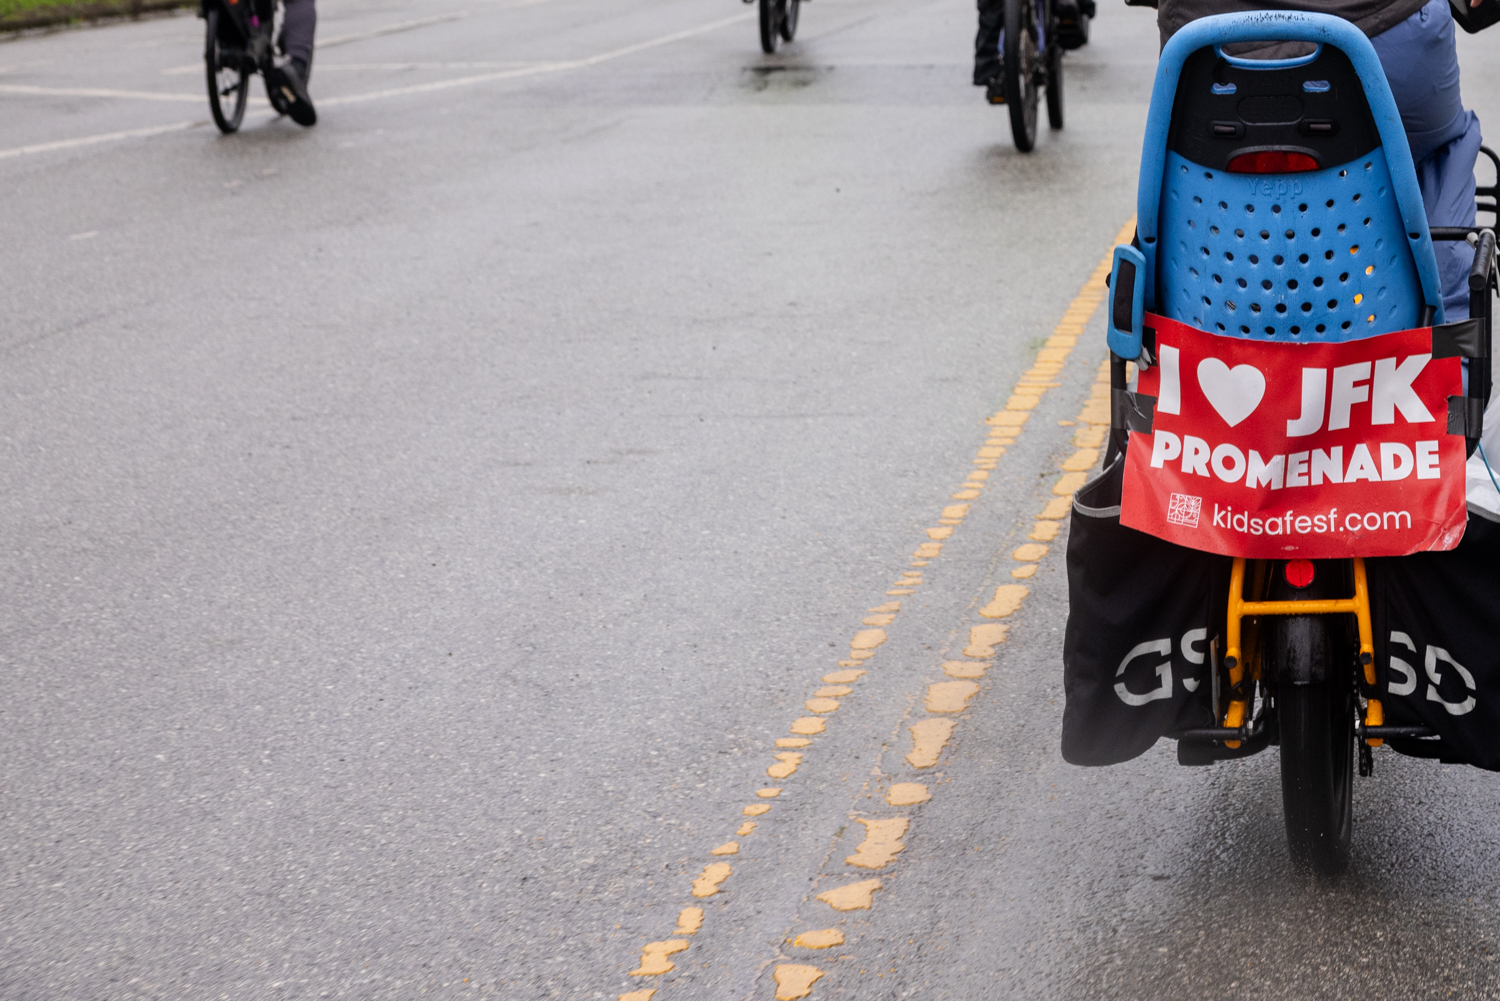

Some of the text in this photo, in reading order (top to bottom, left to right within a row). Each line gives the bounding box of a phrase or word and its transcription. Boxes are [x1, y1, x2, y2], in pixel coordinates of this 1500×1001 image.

[1246, 177, 1304, 200] Yepp
[1157, 344, 1435, 437] I JFK
[1150, 430, 1441, 490] PROMENADE
[1212, 503, 1412, 536] kidsafesf.com
